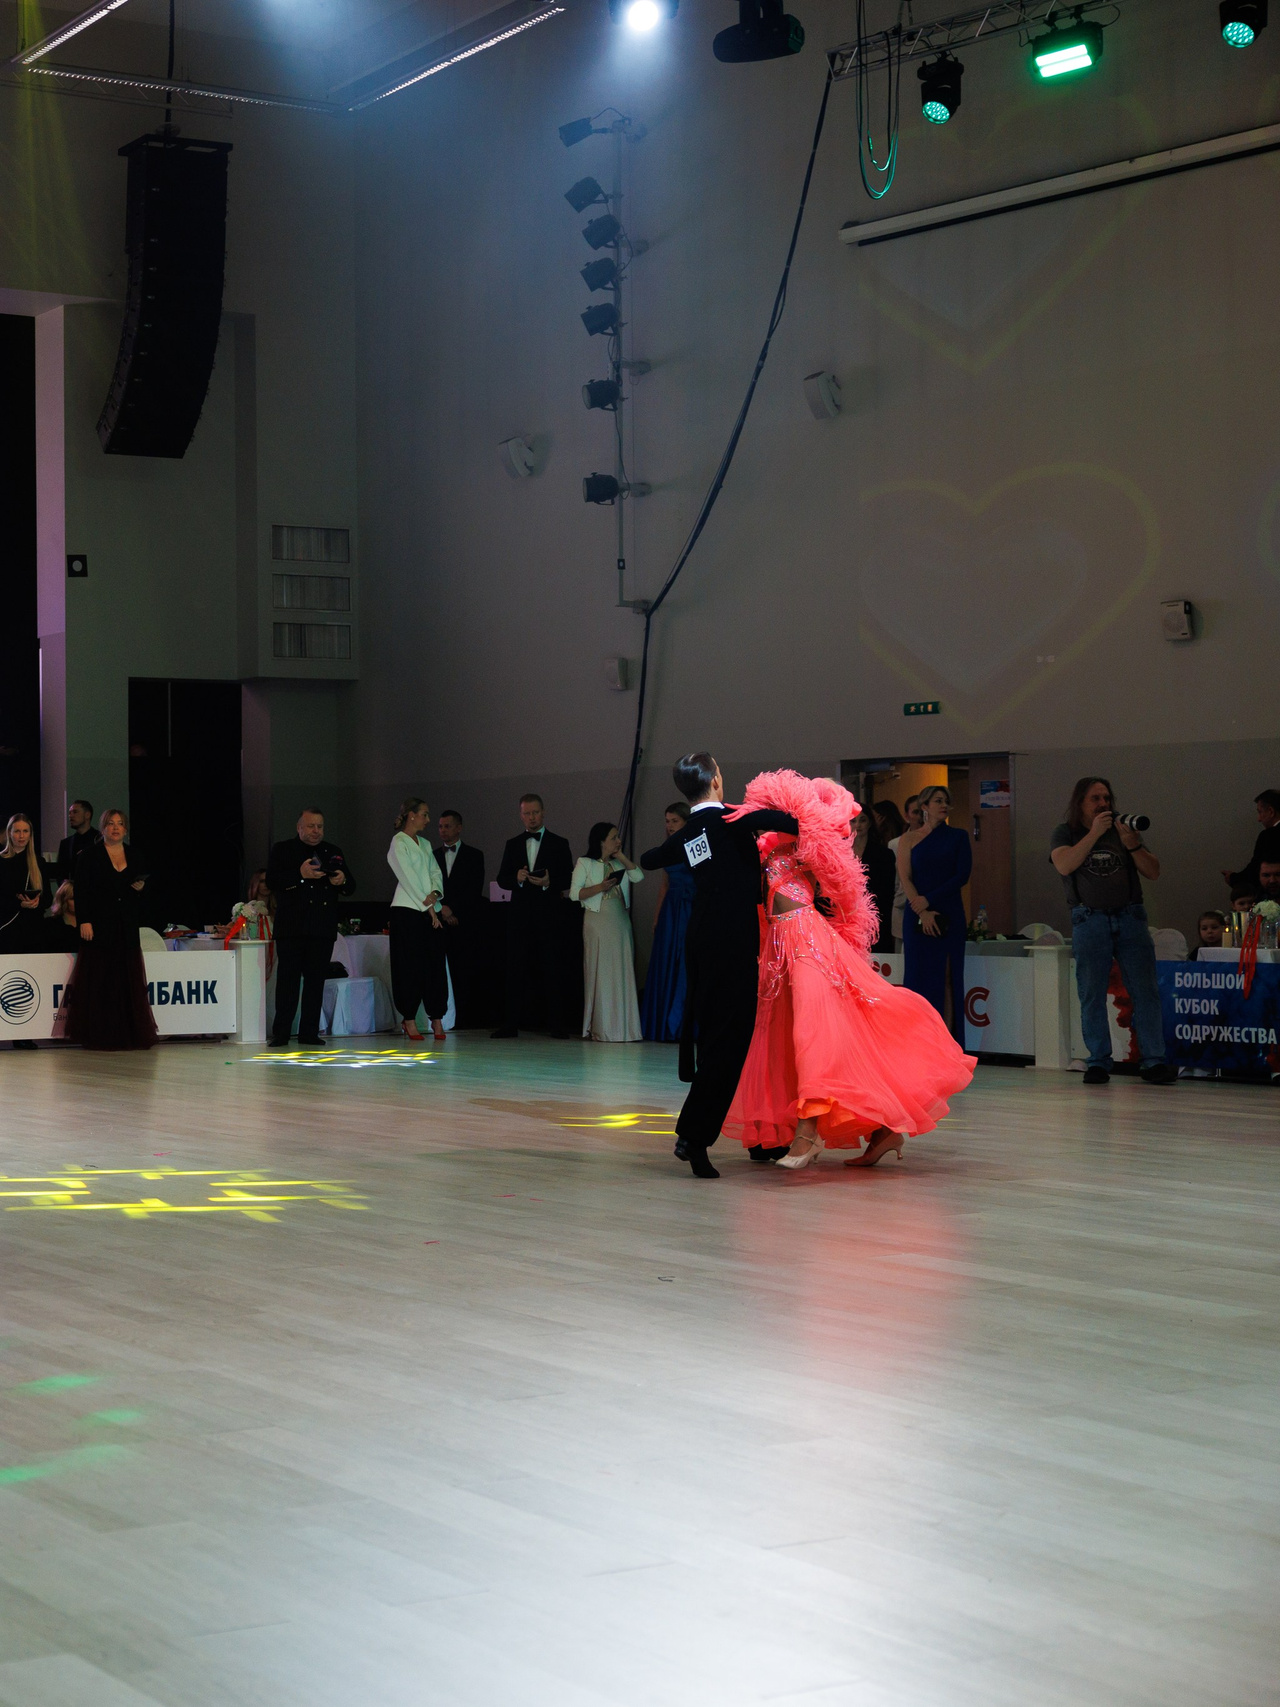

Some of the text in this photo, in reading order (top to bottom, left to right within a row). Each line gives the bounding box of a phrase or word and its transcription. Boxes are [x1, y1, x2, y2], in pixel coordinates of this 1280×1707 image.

[689, 840, 708, 859] 199
[1174, 971, 1245, 990] БОЛЬШОЙ
[1174, 997, 1219, 1015] КУБОК
[1174, 1023, 1278, 1045] СОДРУЖЕСТВА
